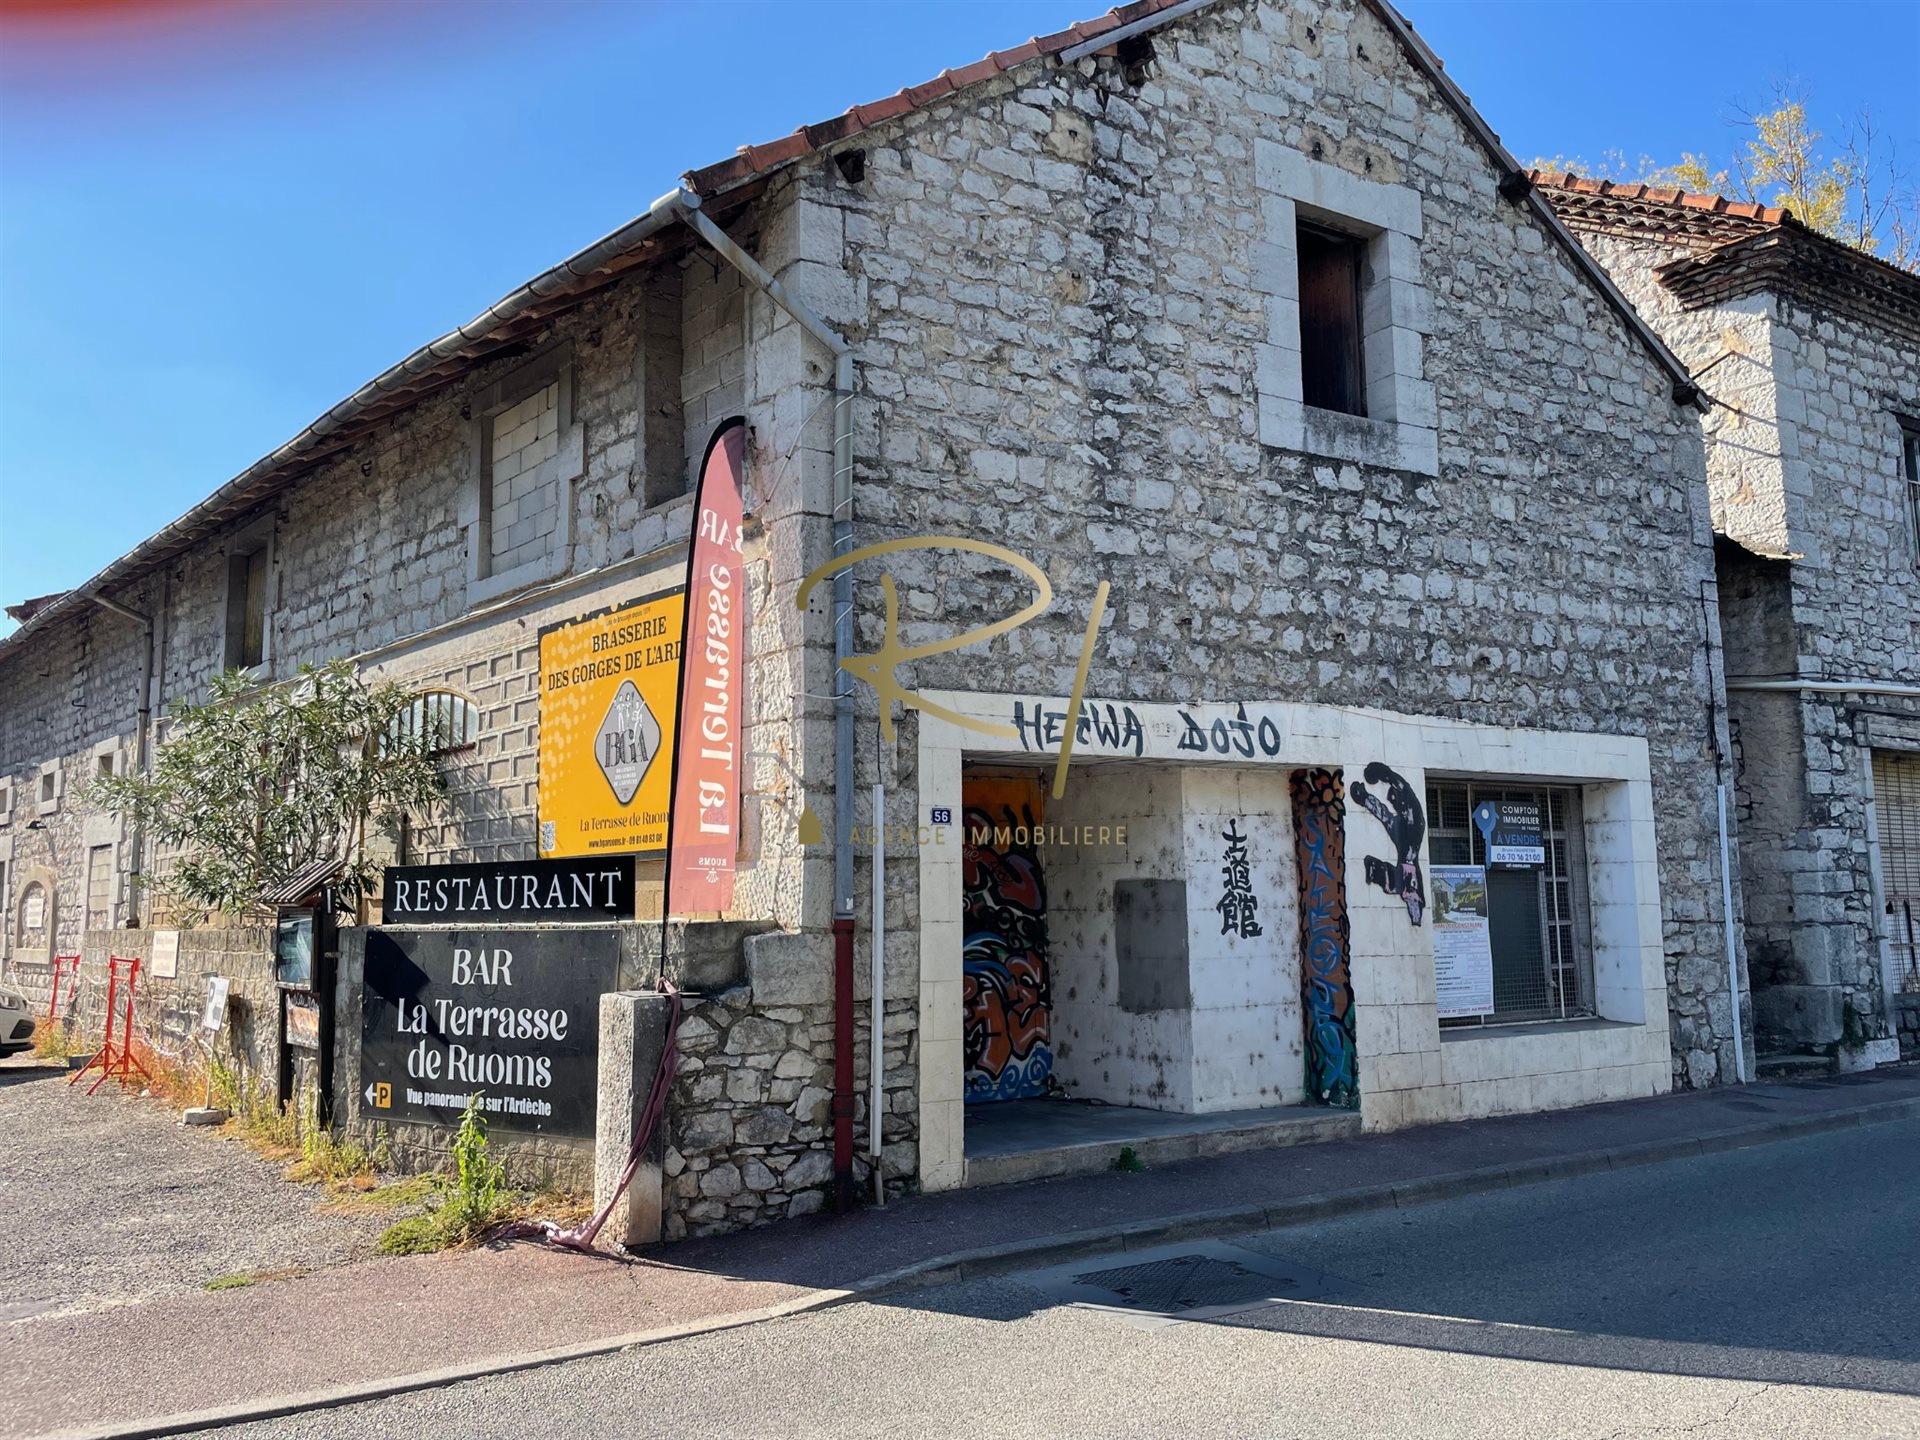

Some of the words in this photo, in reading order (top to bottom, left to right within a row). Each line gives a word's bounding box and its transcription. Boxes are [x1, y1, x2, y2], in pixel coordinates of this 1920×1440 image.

[592, 615, 667, 653] BRASSERIE
[548, 669, 569, 691] DES
[572, 656, 621, 685] GORGES
[625, 650, 642, 671] DE
[604, 727, 649, 768] BGA
[580, 818, 589, 832] La
[591, 816, 628, 831] Terrasse
[629, 812, 641, 827] de
[934, 810, 949, 822] 56
[1502, 805, 1539, 815] COMPTOIR
[1502, 815, 1540, 825] IMMOBILIER
[1504, 834, 1541, 845] VENDRE
[1496, 853, 1506, 861] 06
[1507, 853, 1516, 861] 70
[1525, 853, 1532, 861] 21
[393, 870, 622, 912] RESTAURANT
[451, 949, 513, 986] BAR
[397, 998, 428, 1035] La
[435, 999, 568, 1041] Terrasse
[407, 1039, 442, 1080] de
[448, 1044, 552, 1089] Ruoms
[407, 1088, 423, 1104] Vue
[486, 1097, 503, 1112] sur
[504, 1096, 552, 1117] l'Ardèche
